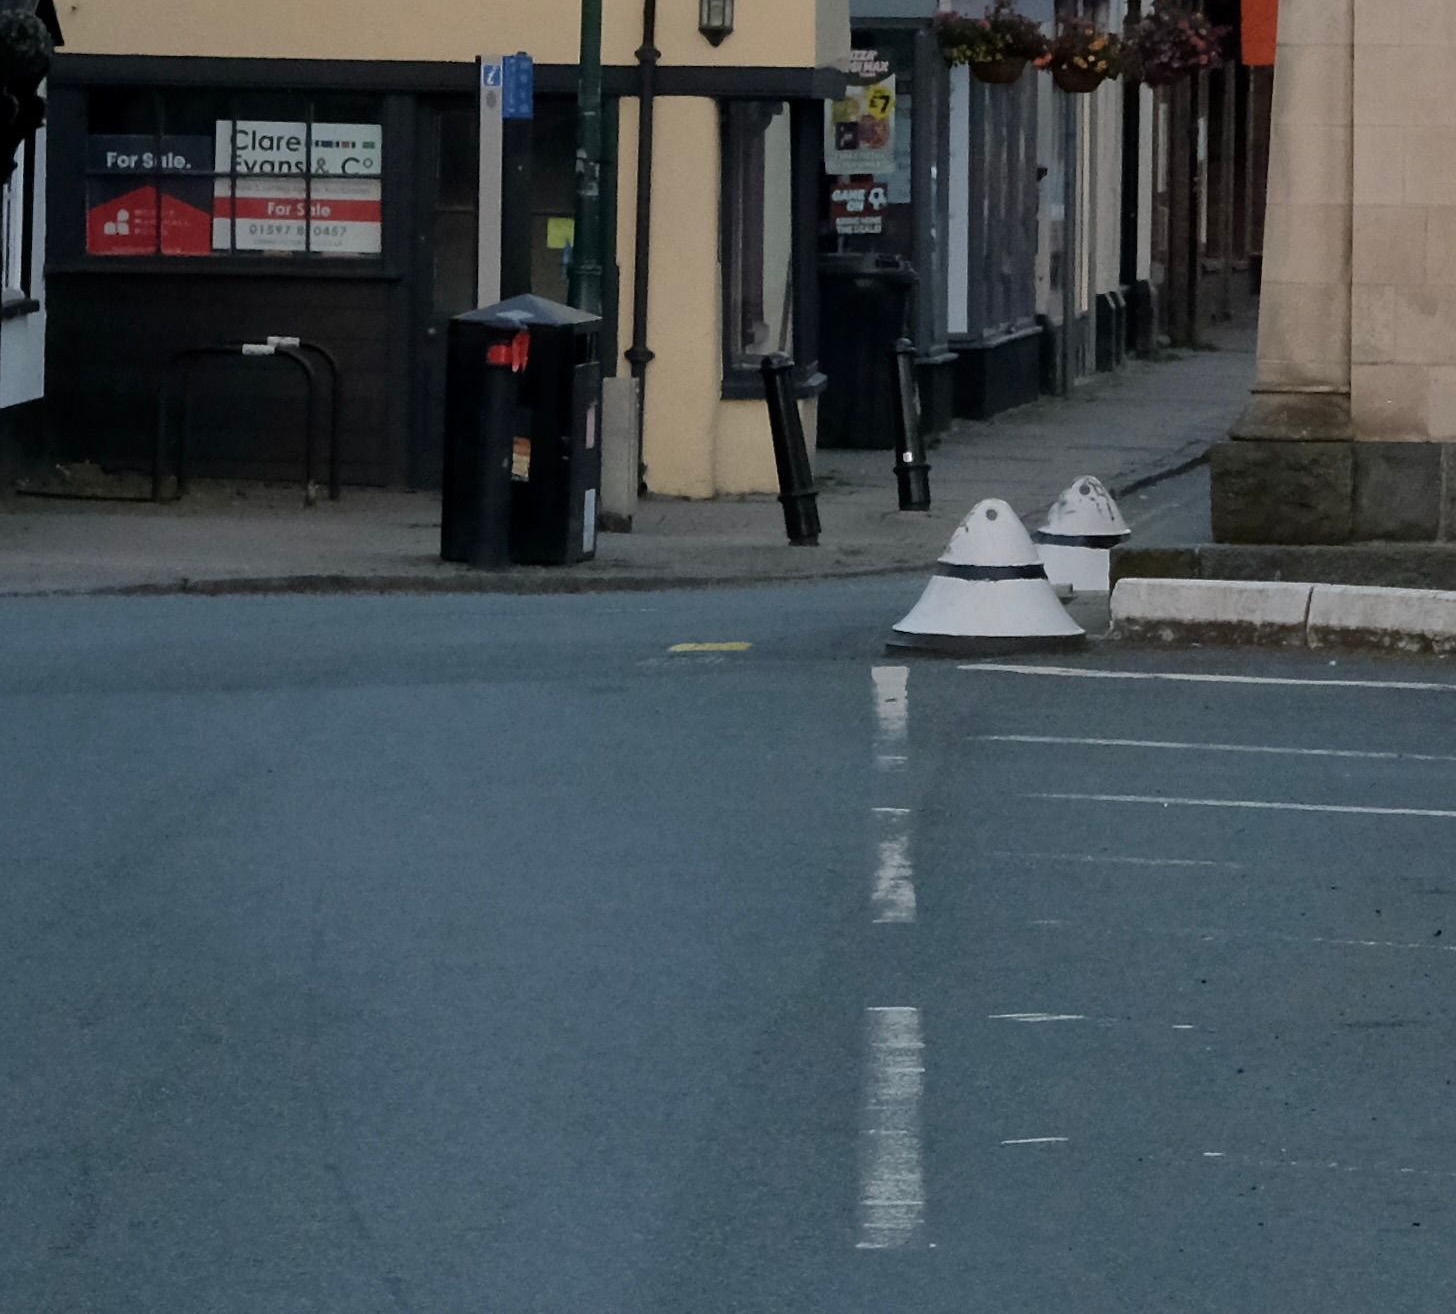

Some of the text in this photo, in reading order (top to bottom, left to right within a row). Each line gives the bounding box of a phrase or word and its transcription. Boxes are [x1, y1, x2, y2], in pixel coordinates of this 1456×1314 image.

[232, 130, 302, 152] Clare
[106, 152, 138, 168] For
[315, 157, 330, 173] &
[267, 202, 291, 216] For
[249, 224, 347, 237] 01597 80457
